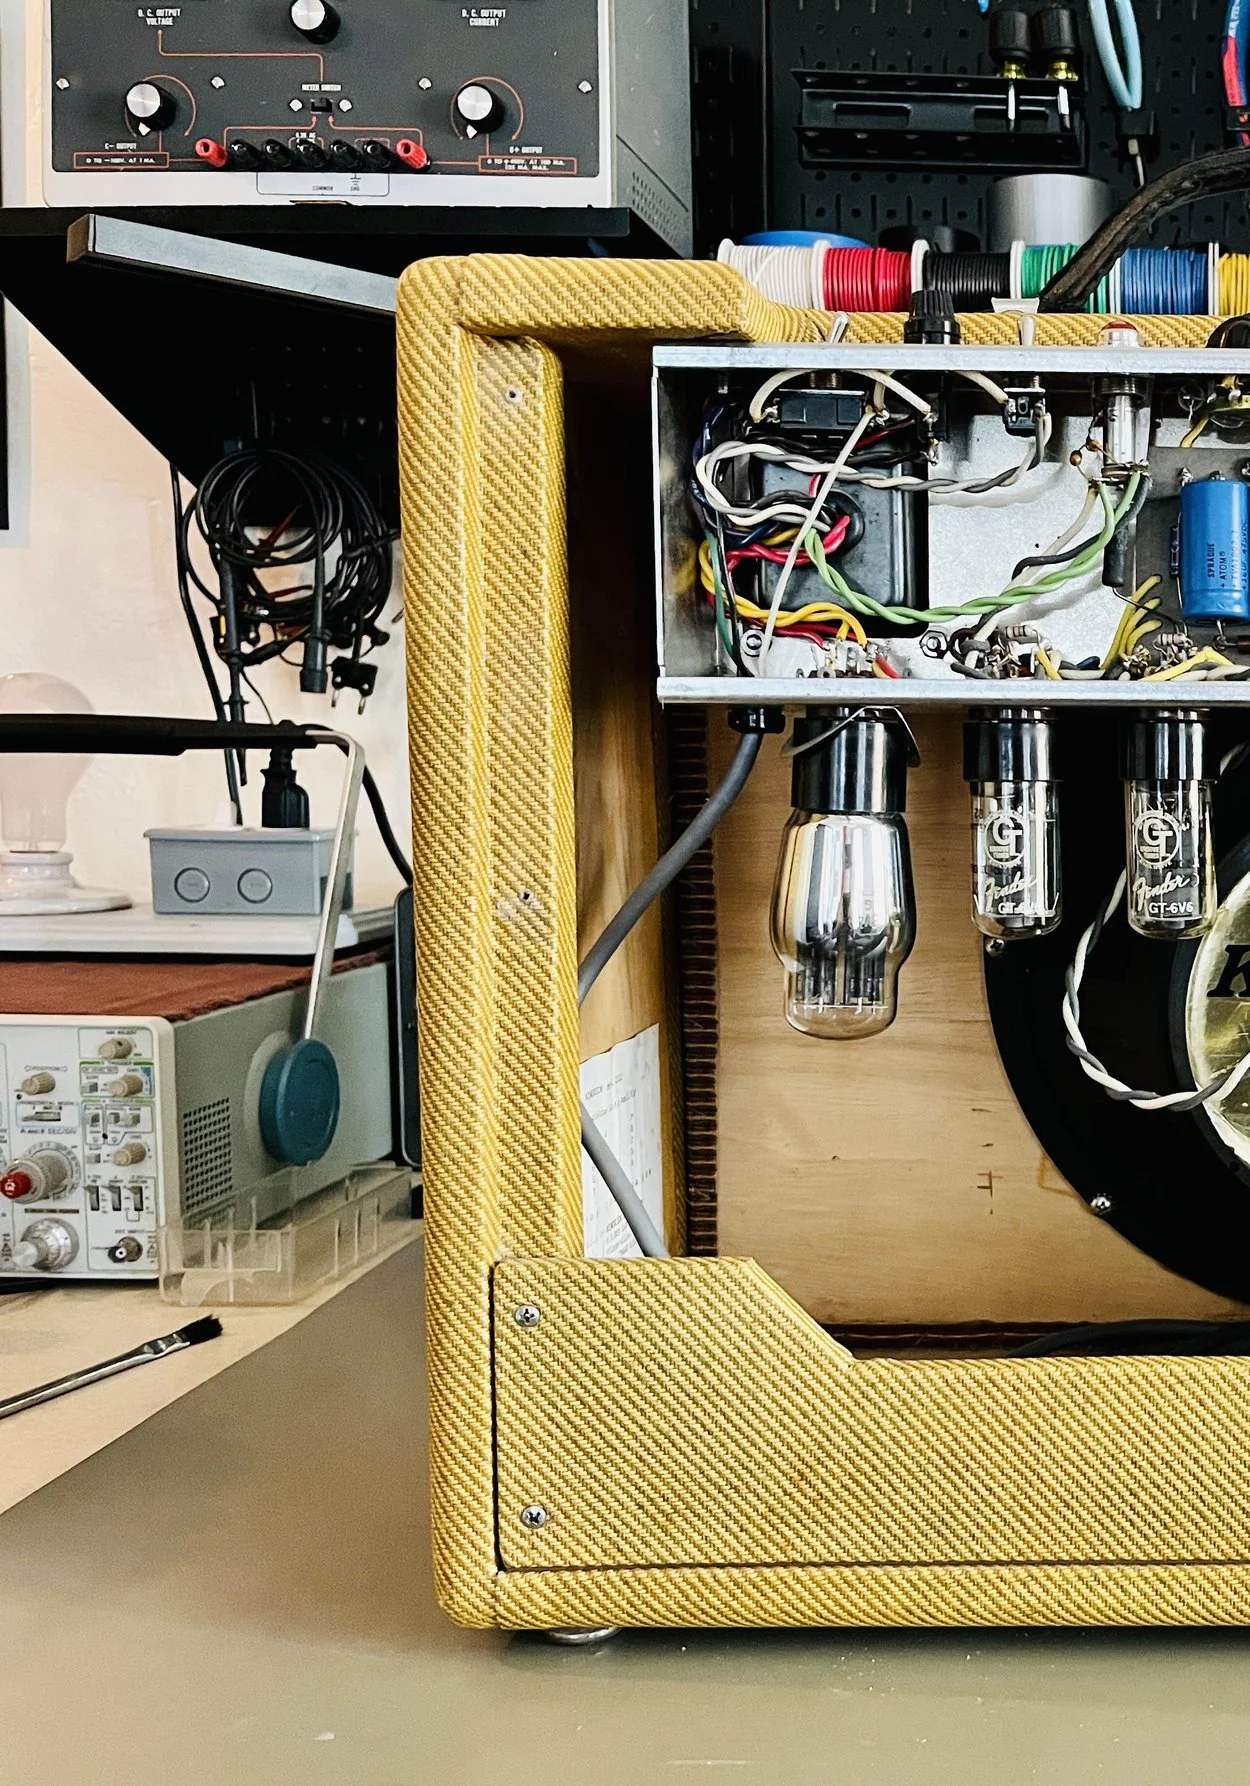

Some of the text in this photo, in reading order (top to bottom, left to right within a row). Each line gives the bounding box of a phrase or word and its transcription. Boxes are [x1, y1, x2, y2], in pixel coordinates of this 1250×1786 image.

[1207, 543, 1215, 578] SPRAGUE
[1133, 871, 1190, 911] Fender
[1149, 901, 1193, 915] GT-6V6
